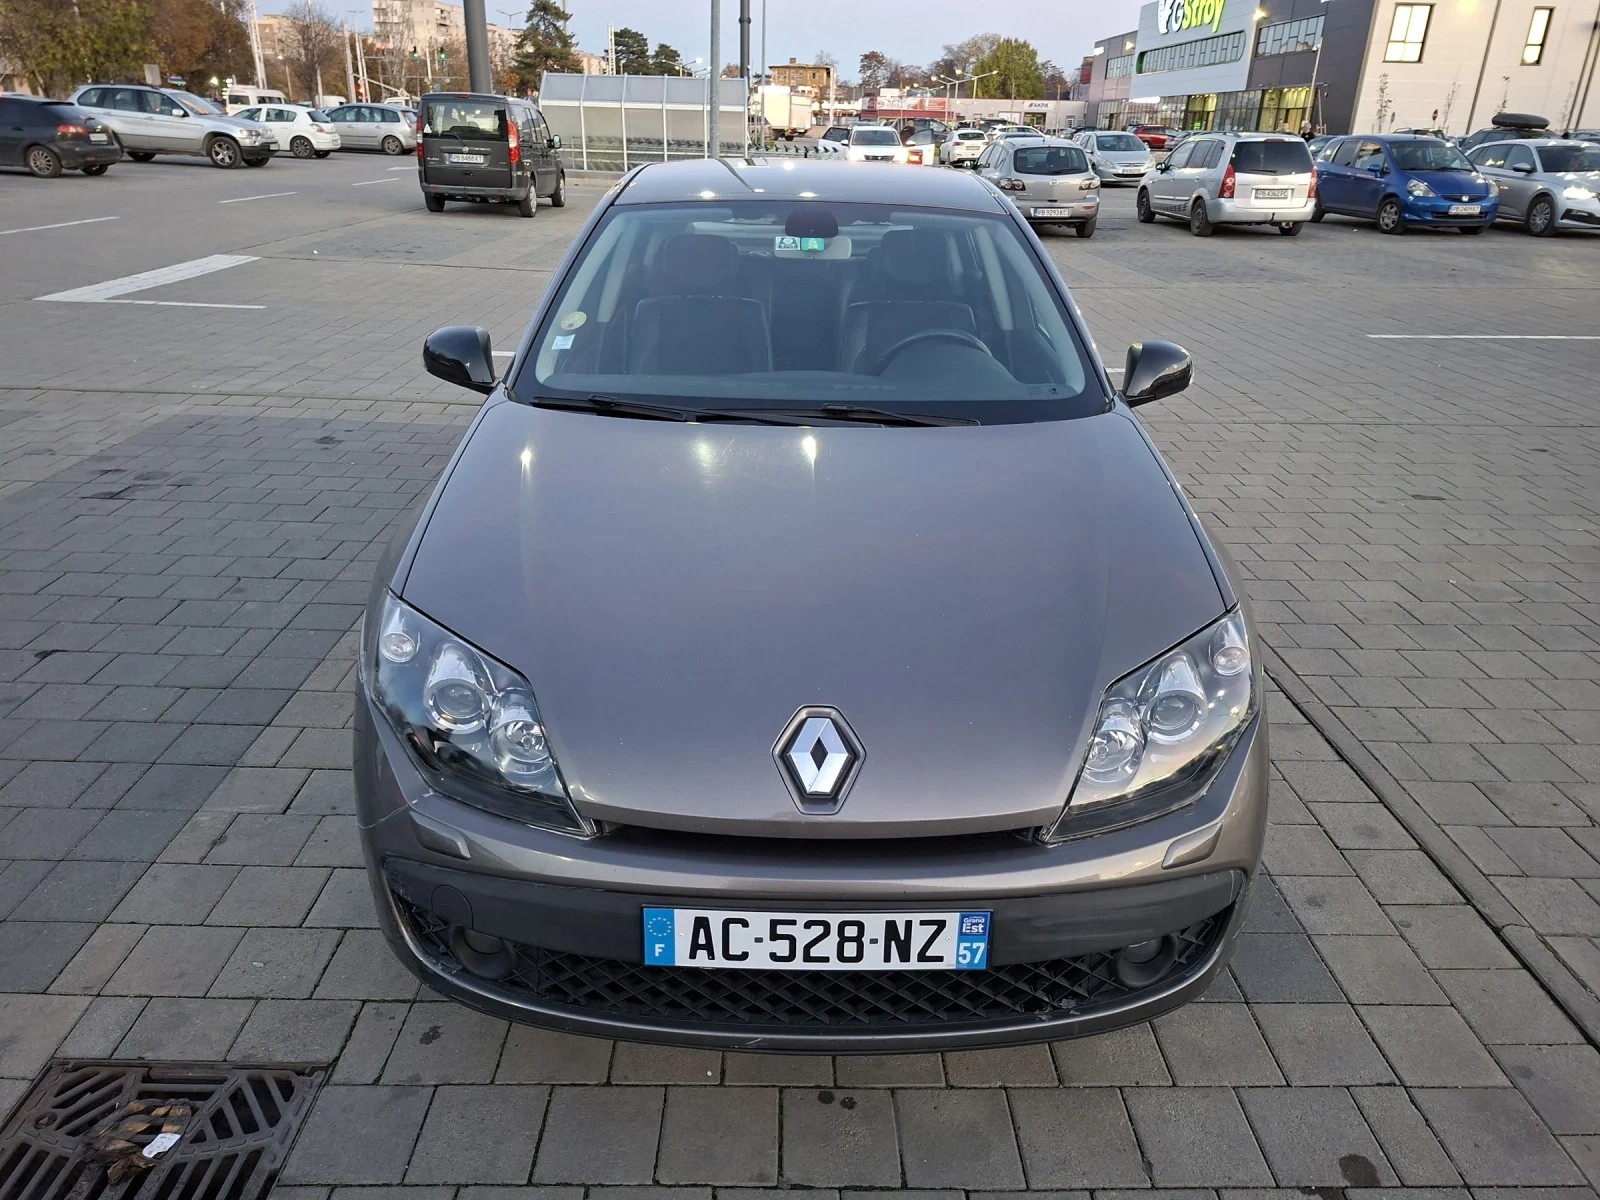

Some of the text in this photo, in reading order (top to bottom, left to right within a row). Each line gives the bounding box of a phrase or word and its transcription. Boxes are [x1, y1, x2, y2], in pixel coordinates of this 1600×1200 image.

[962, 922, 985, 933] Est
[688, 915, 947, 964] AC-528-NZ
[654, 943, 665, 957] F
[958, 942, 985, 964] 57
